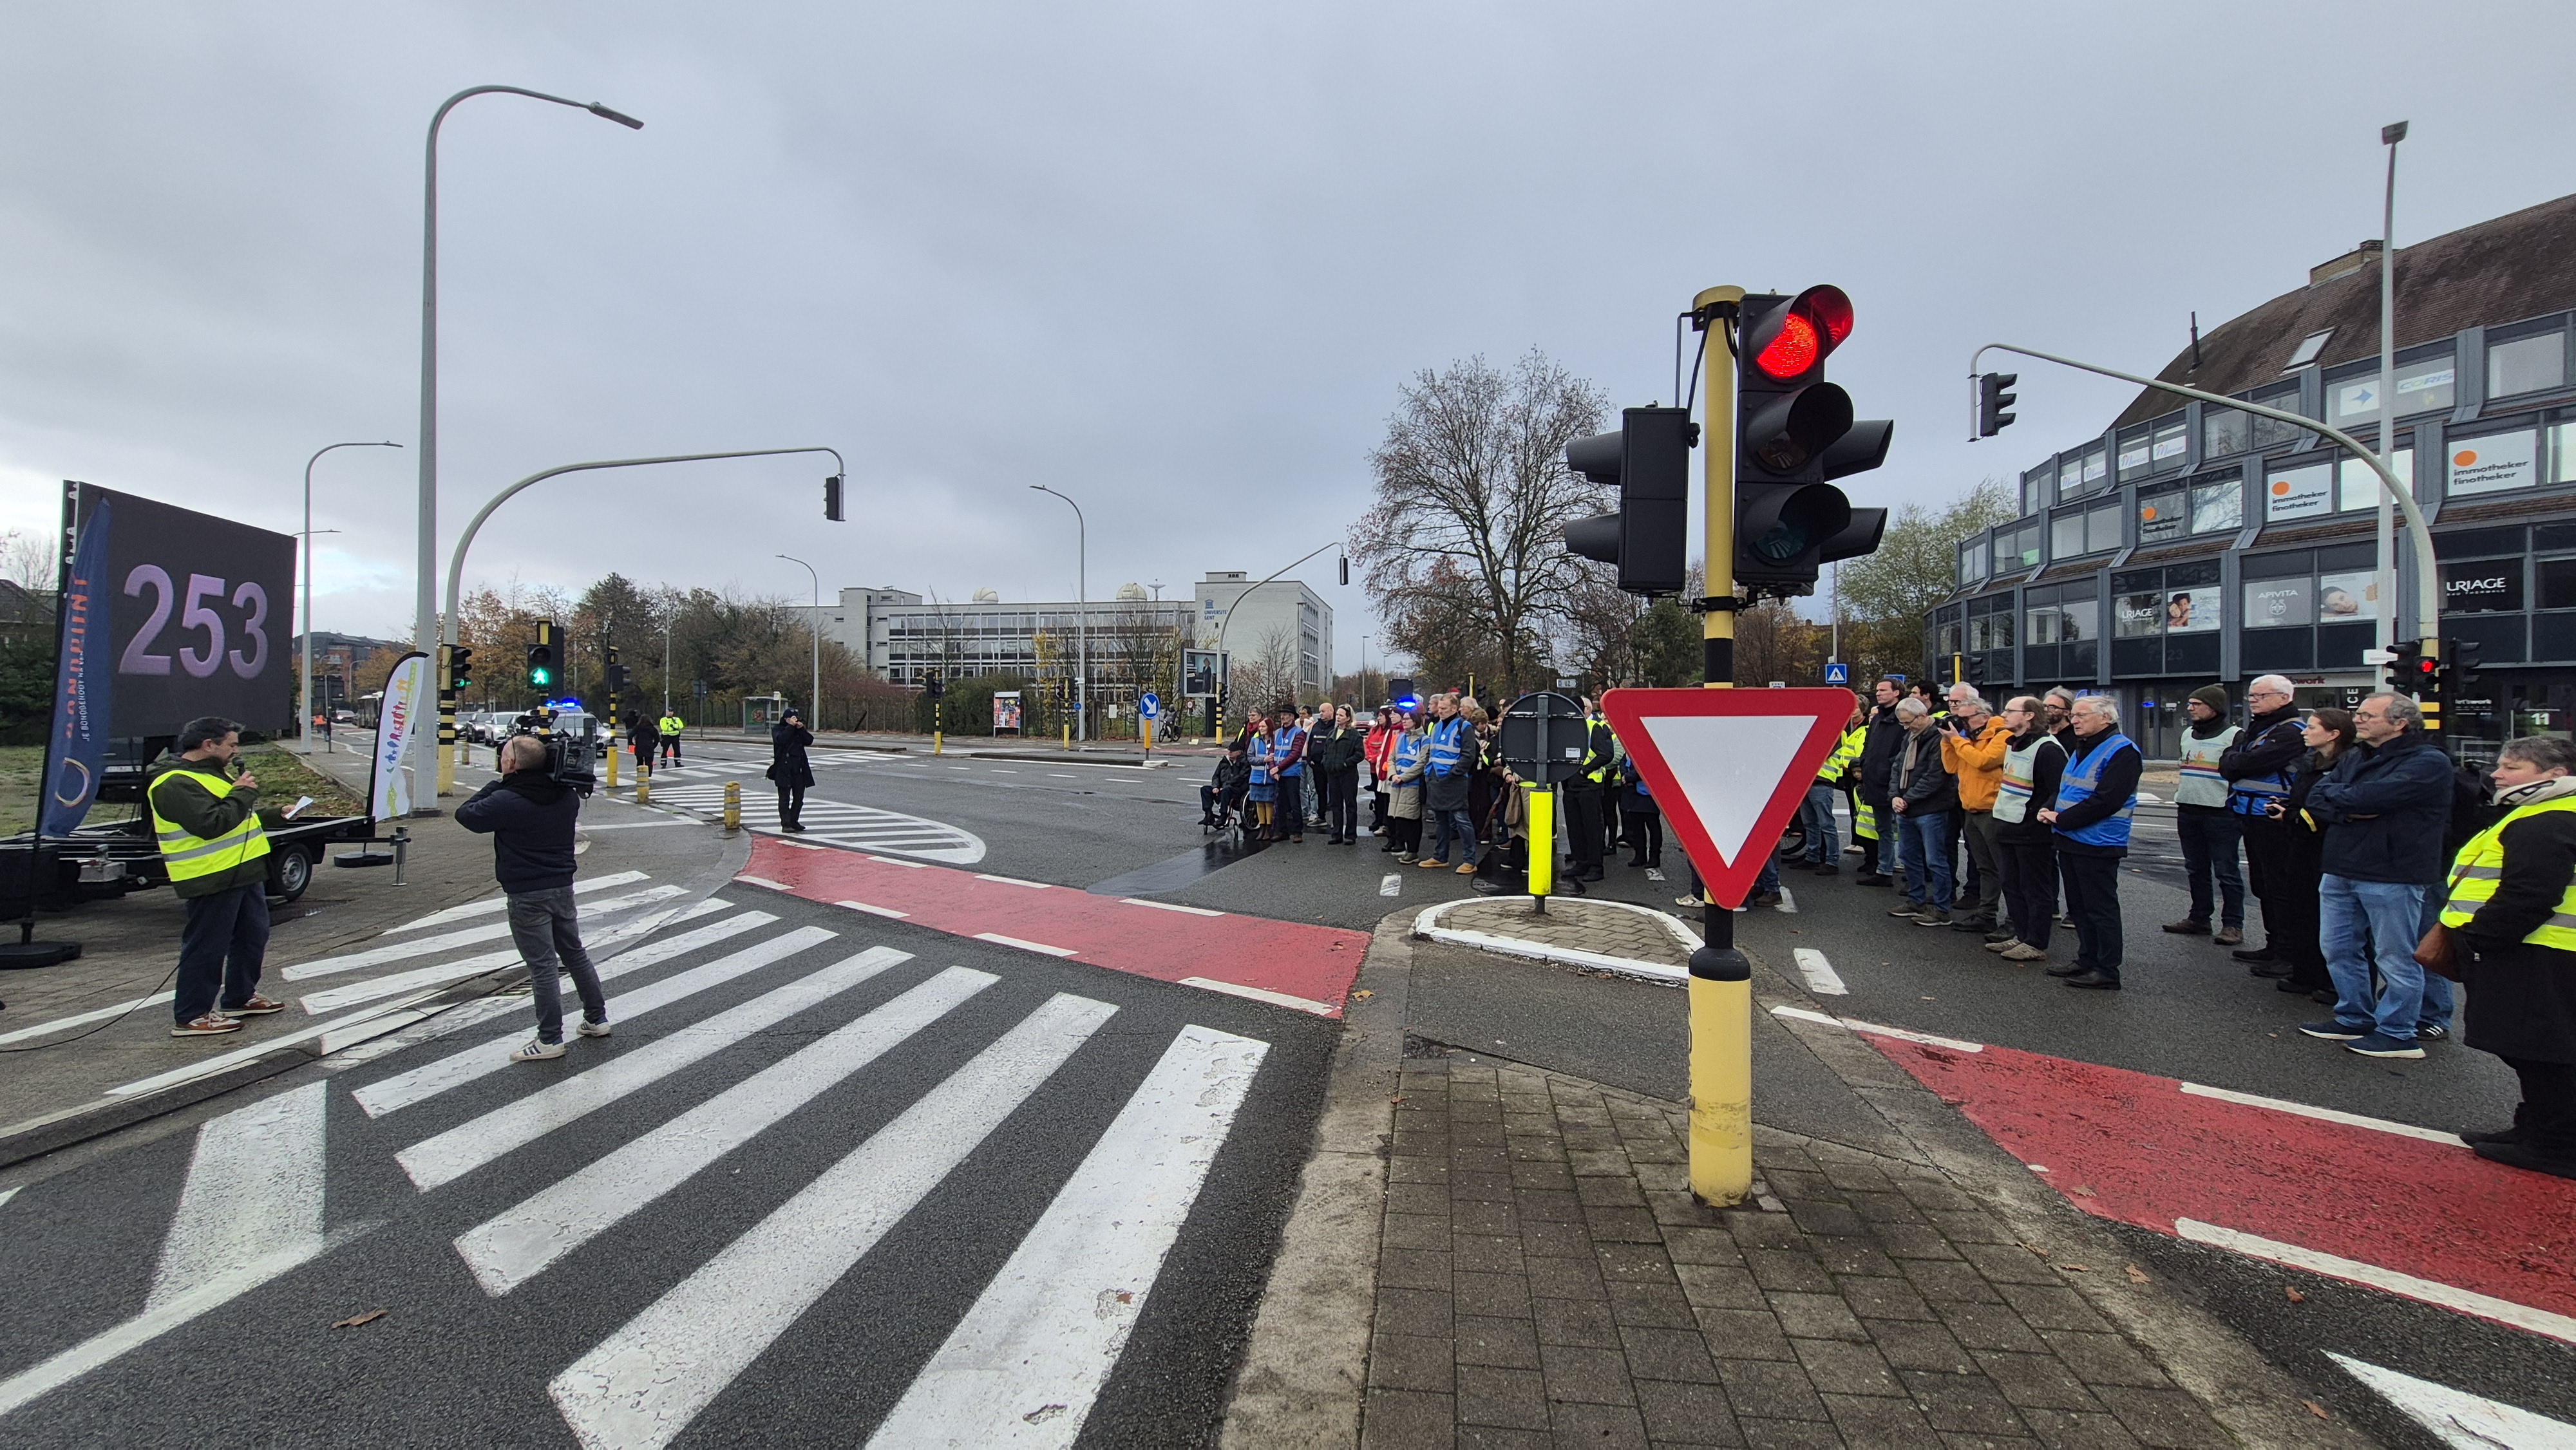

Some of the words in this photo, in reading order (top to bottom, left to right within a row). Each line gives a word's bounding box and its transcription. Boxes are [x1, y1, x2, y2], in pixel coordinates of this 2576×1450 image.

[2400, 373, 2453, 390] CORIS
[2454, 461, 2528, 476] immotheker
[2453, 472, 2517, 485] finotheker
[2272, 491, 2328, 504] immotheker
[2272, 501, 2320, 512] finotheker
[2447, 578, 2506, 591] URIAGE
[2257, 590, 2298, 599] APIVITA
[2122, 608, 2153, 619] URIAGE
[118, 563, 269, 680] 253
[2347, 688, 2358, 709] ICE
[2531, 713, 2550, 725] 11
